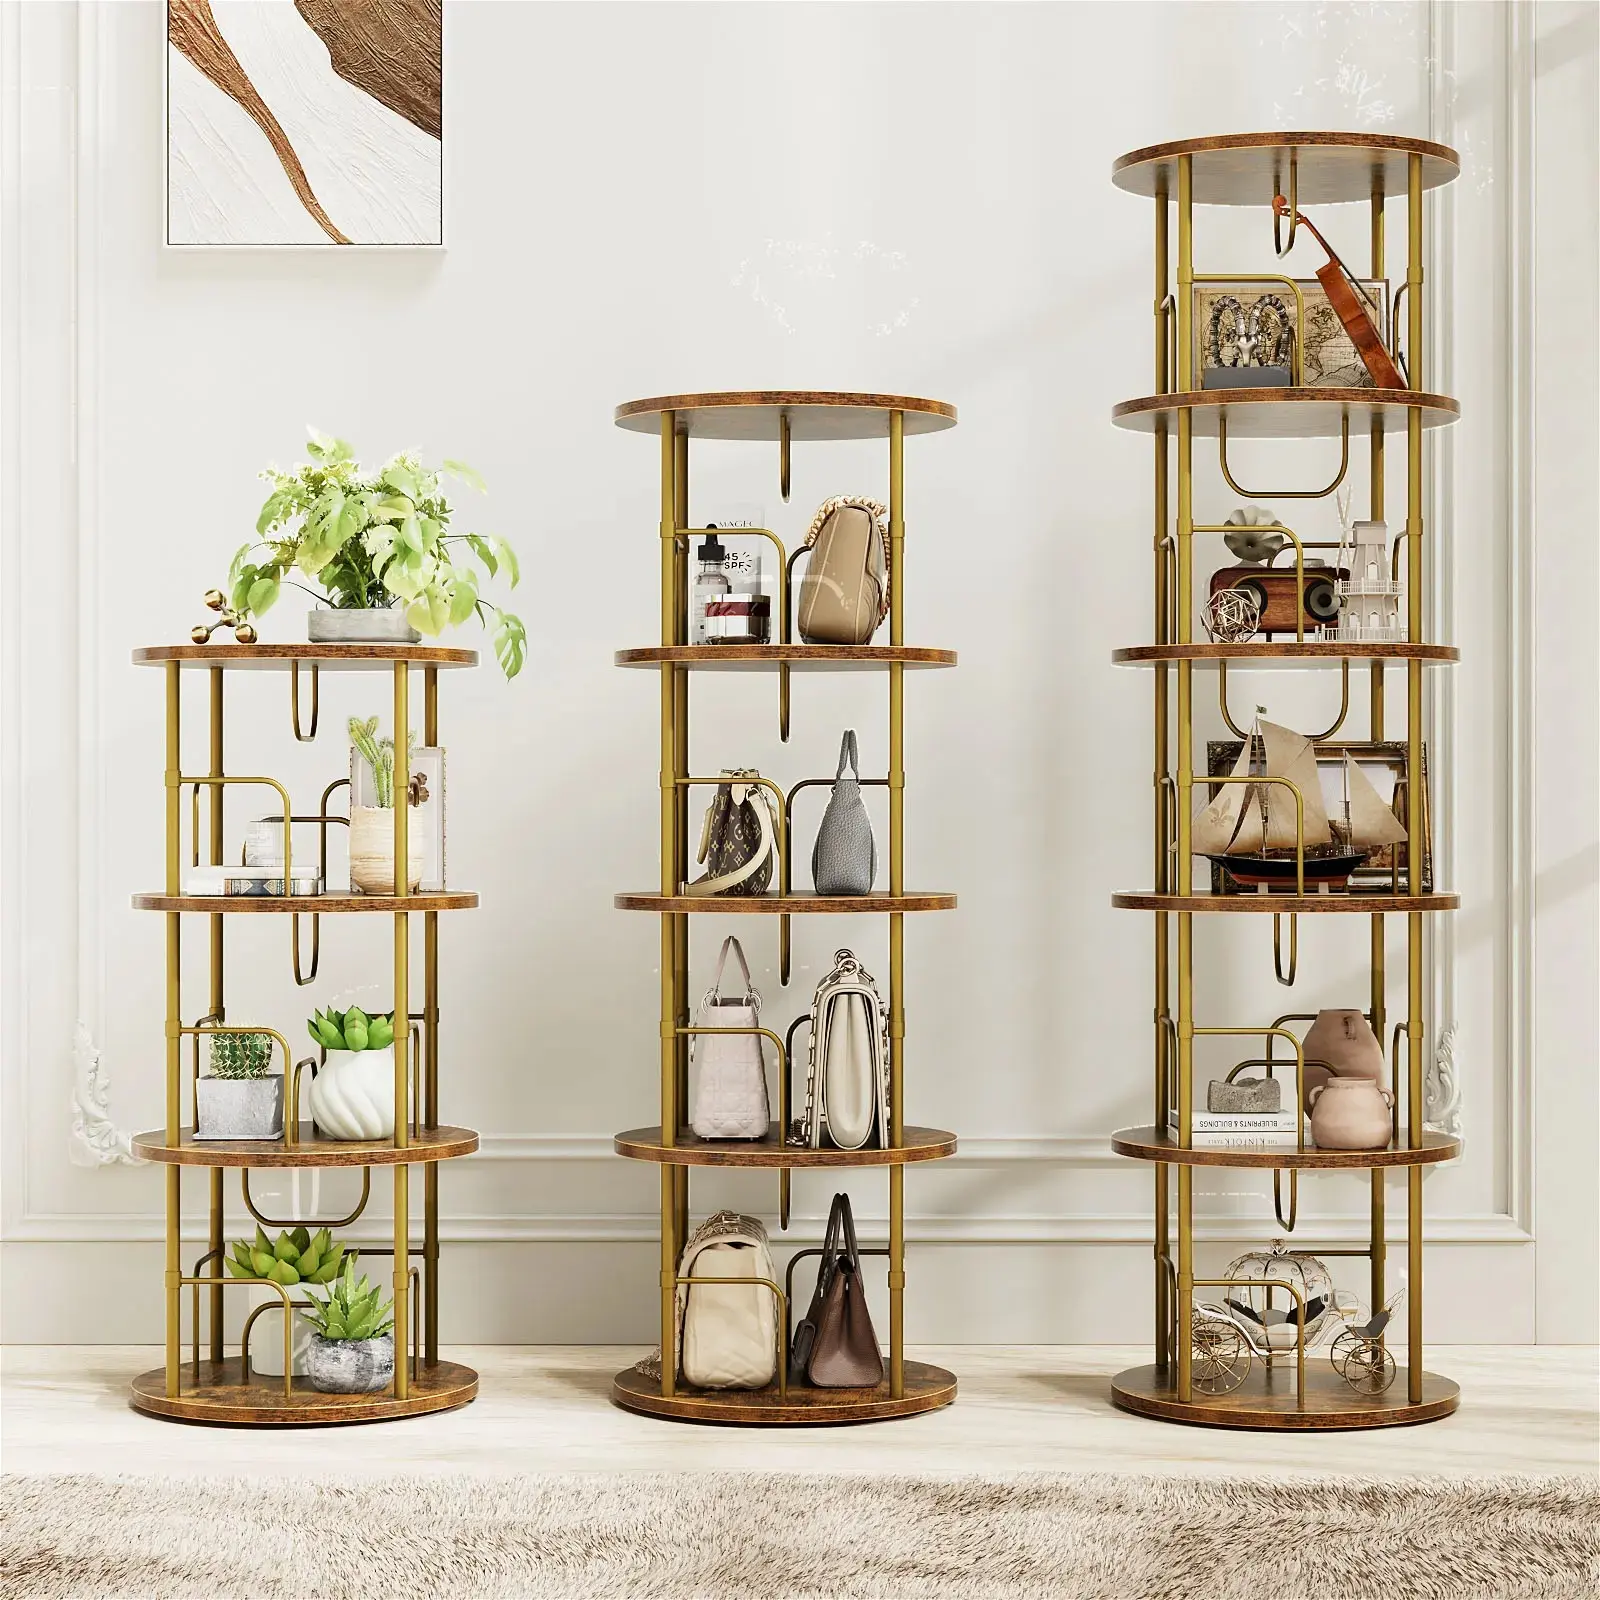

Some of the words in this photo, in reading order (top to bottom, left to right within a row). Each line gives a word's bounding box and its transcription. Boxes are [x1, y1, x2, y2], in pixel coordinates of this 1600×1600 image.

[724, 552, 739, 561] 45
[724, 561, 745, 570] SPF
[1199, 1120, 1233, 1128] BUILDINGS
[1233, 1120, 1239, 1128] &
[1240, 1120, 1278, 1128] BLUEPRINTS
